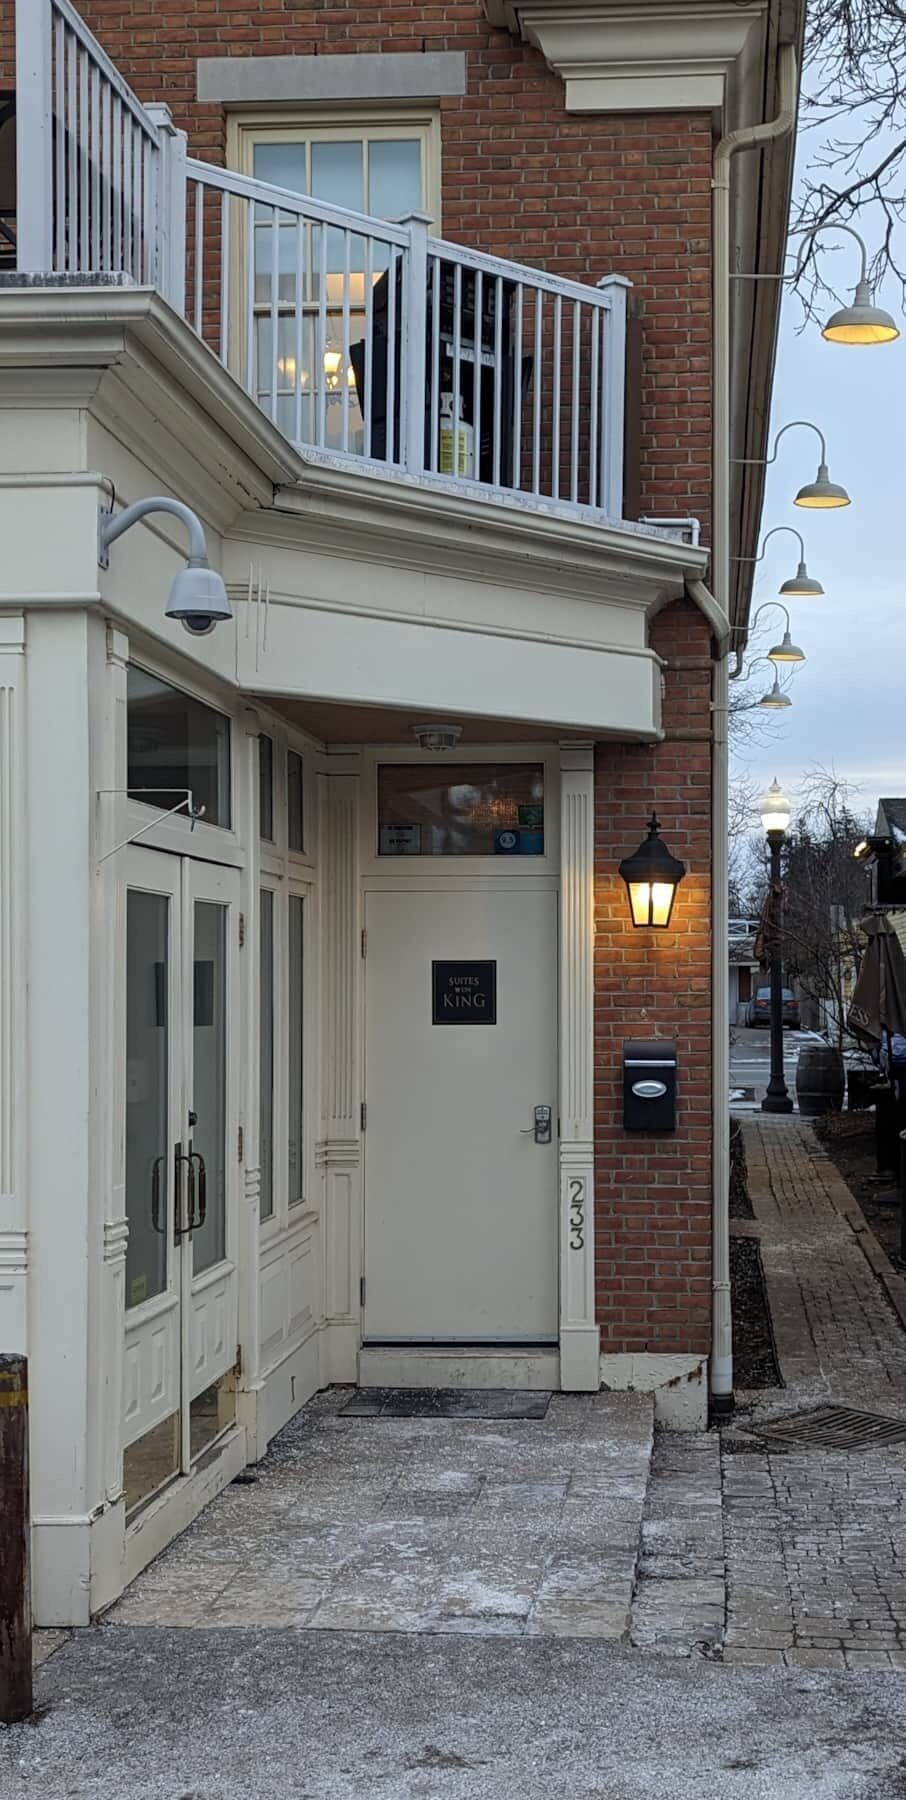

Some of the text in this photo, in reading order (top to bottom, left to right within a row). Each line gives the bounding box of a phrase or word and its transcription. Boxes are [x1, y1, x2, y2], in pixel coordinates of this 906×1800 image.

[448, 976, 480, 986] SUITES
[443, 993, 486, 1008] KING
[569, 1180, 585, 1251] 233
